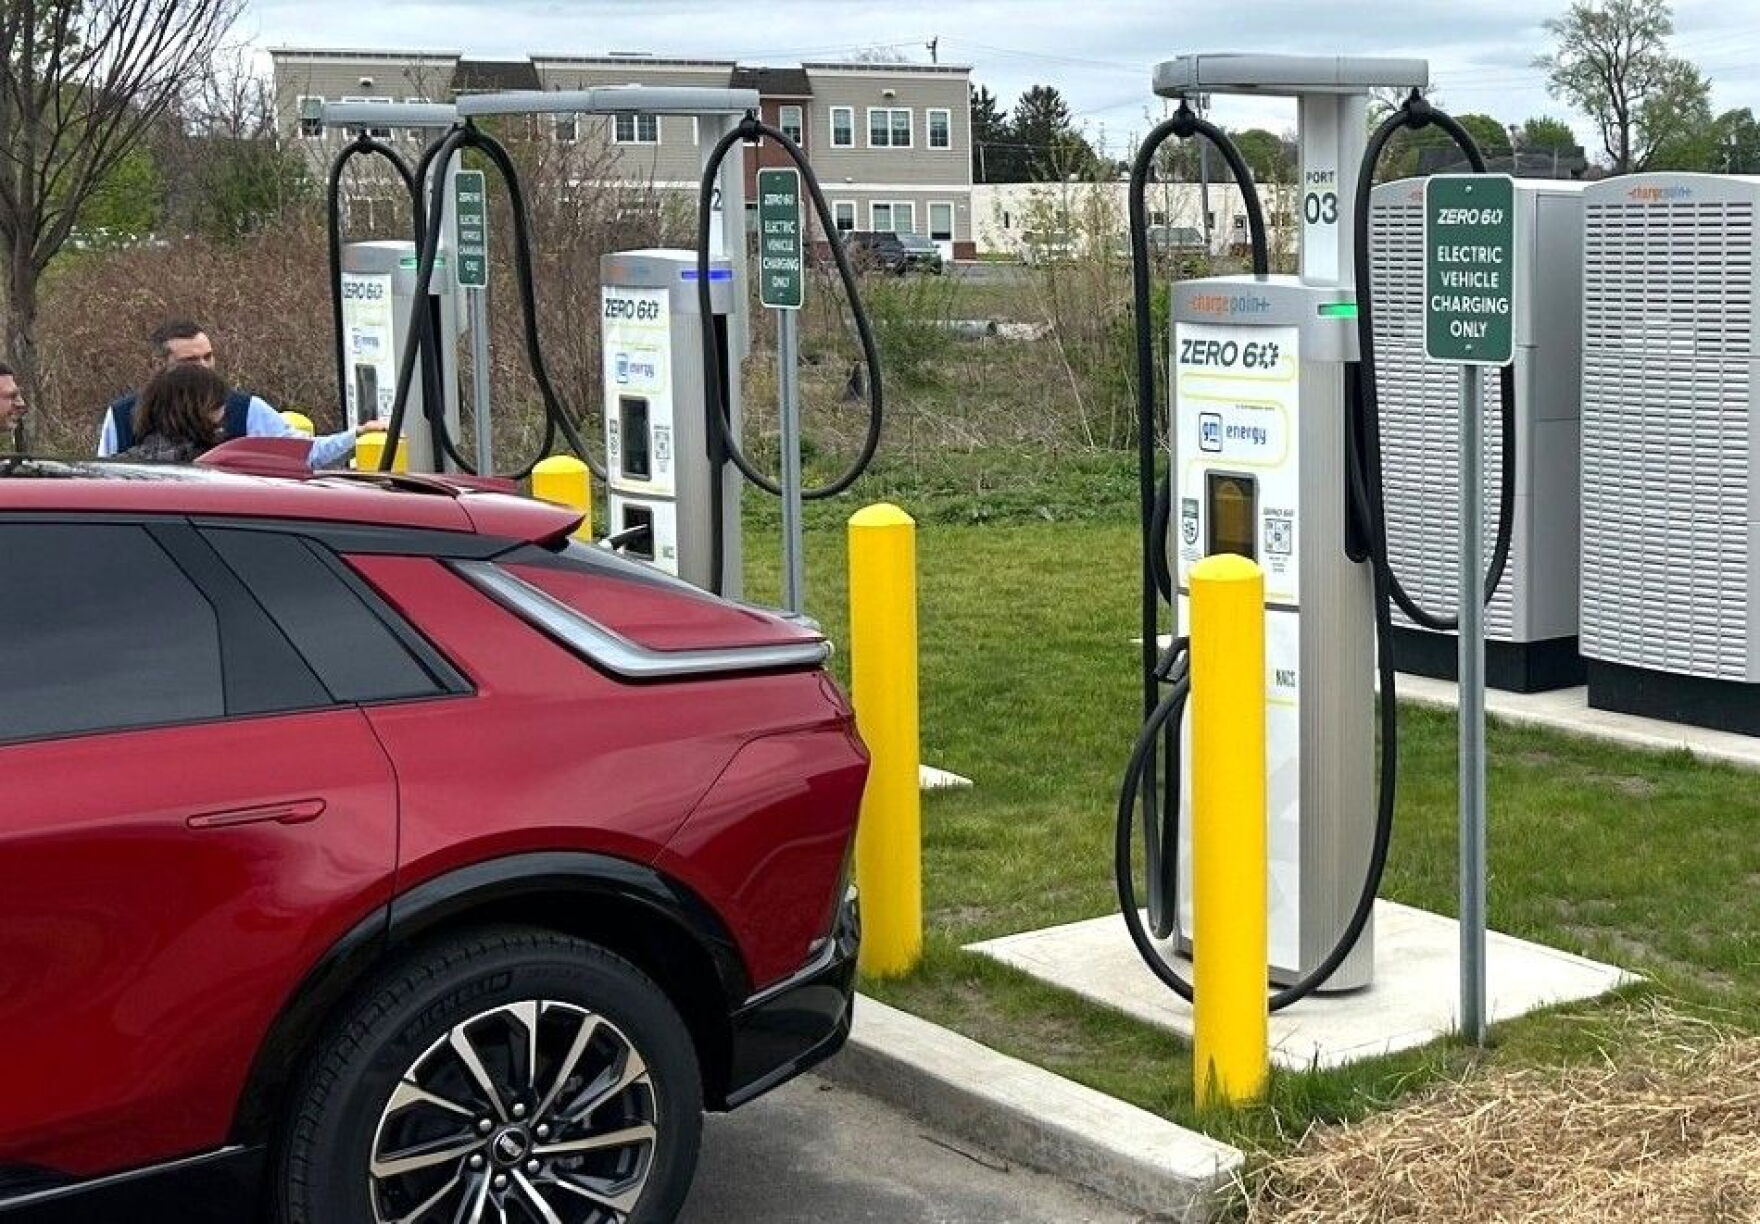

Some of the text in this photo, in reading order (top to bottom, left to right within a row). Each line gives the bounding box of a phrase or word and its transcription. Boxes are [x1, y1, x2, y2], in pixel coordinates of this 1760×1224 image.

[1306, 171, 1335, 184] PORT
[711, 188, 721, 211] 2
[1304, 192, 1338, 224] 03
[1437, 208, 1479, 226] ZERO
[1437, 245, 1502, 264] ELECTRIC
[1441, 270, 1499, 289] VEHICLE
[605, 298, 634, 319] ZERO
[1431, 295, 1509, 314] CHARGING
[1450, 319, 1487, 338] ONLY
[1180, 339, 1238, 367] ZERO
[1226, 425, 1266, 445] energy
